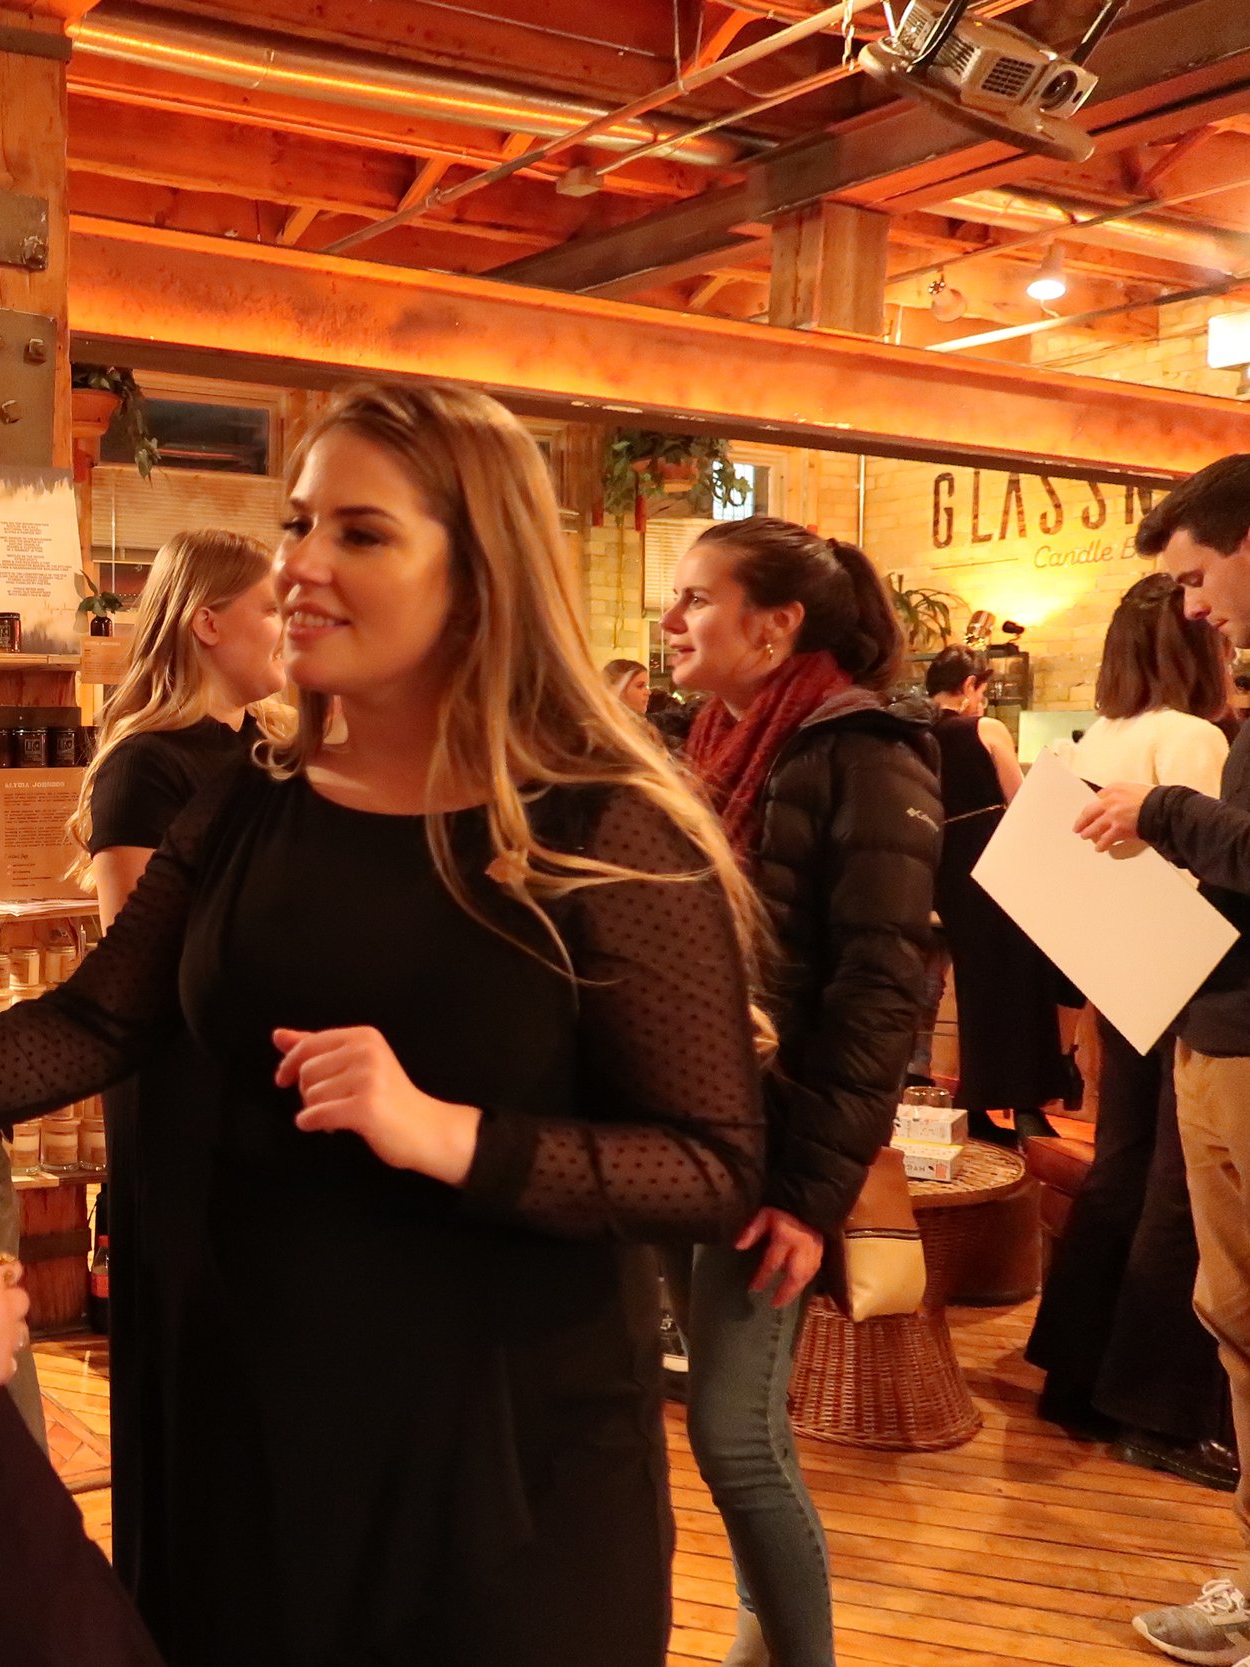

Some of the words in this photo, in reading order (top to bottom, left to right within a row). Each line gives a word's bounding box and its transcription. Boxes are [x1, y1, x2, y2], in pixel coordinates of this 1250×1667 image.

[933, 467, 1153, 549] GLASSN
[1034, 539, 1114, 568] Candle
[1121, 536, 1137, 559] B
